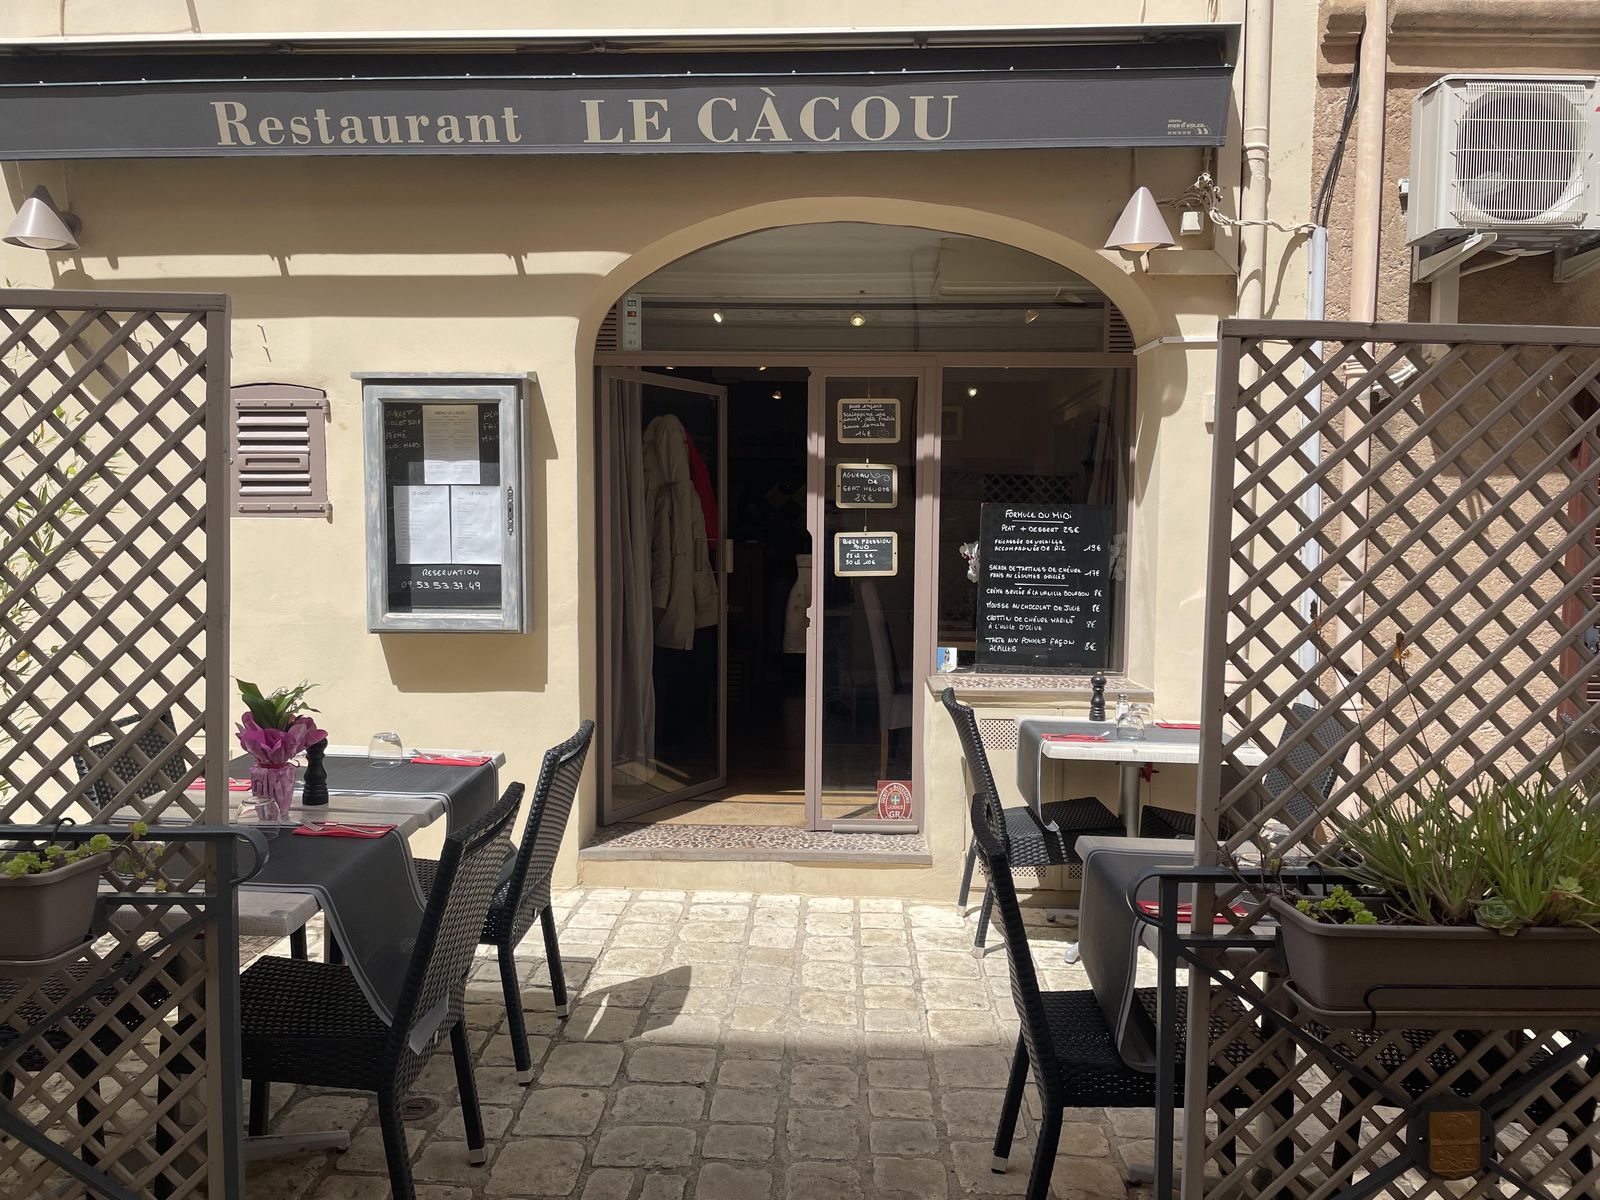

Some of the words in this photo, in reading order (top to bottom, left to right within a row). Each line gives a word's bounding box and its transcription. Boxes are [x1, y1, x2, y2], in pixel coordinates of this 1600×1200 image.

[210, 101, 522, 146] Restaurant
[580, 99, 671, 144] LE
[697, 87, 959, 143] CÀCOU
[1005, 510, 1036, 518] FORMULE
[1052, 510, 1072, 520] MIDI
[1002, 524, 1016, 532] PLAT
[422, 568, 480, 576] RESERVATION
[986, 601, 1010, 609] MOUSSE
[1084, 642, 1096, 652] 8€
[888, 810, 901, 818] GR
